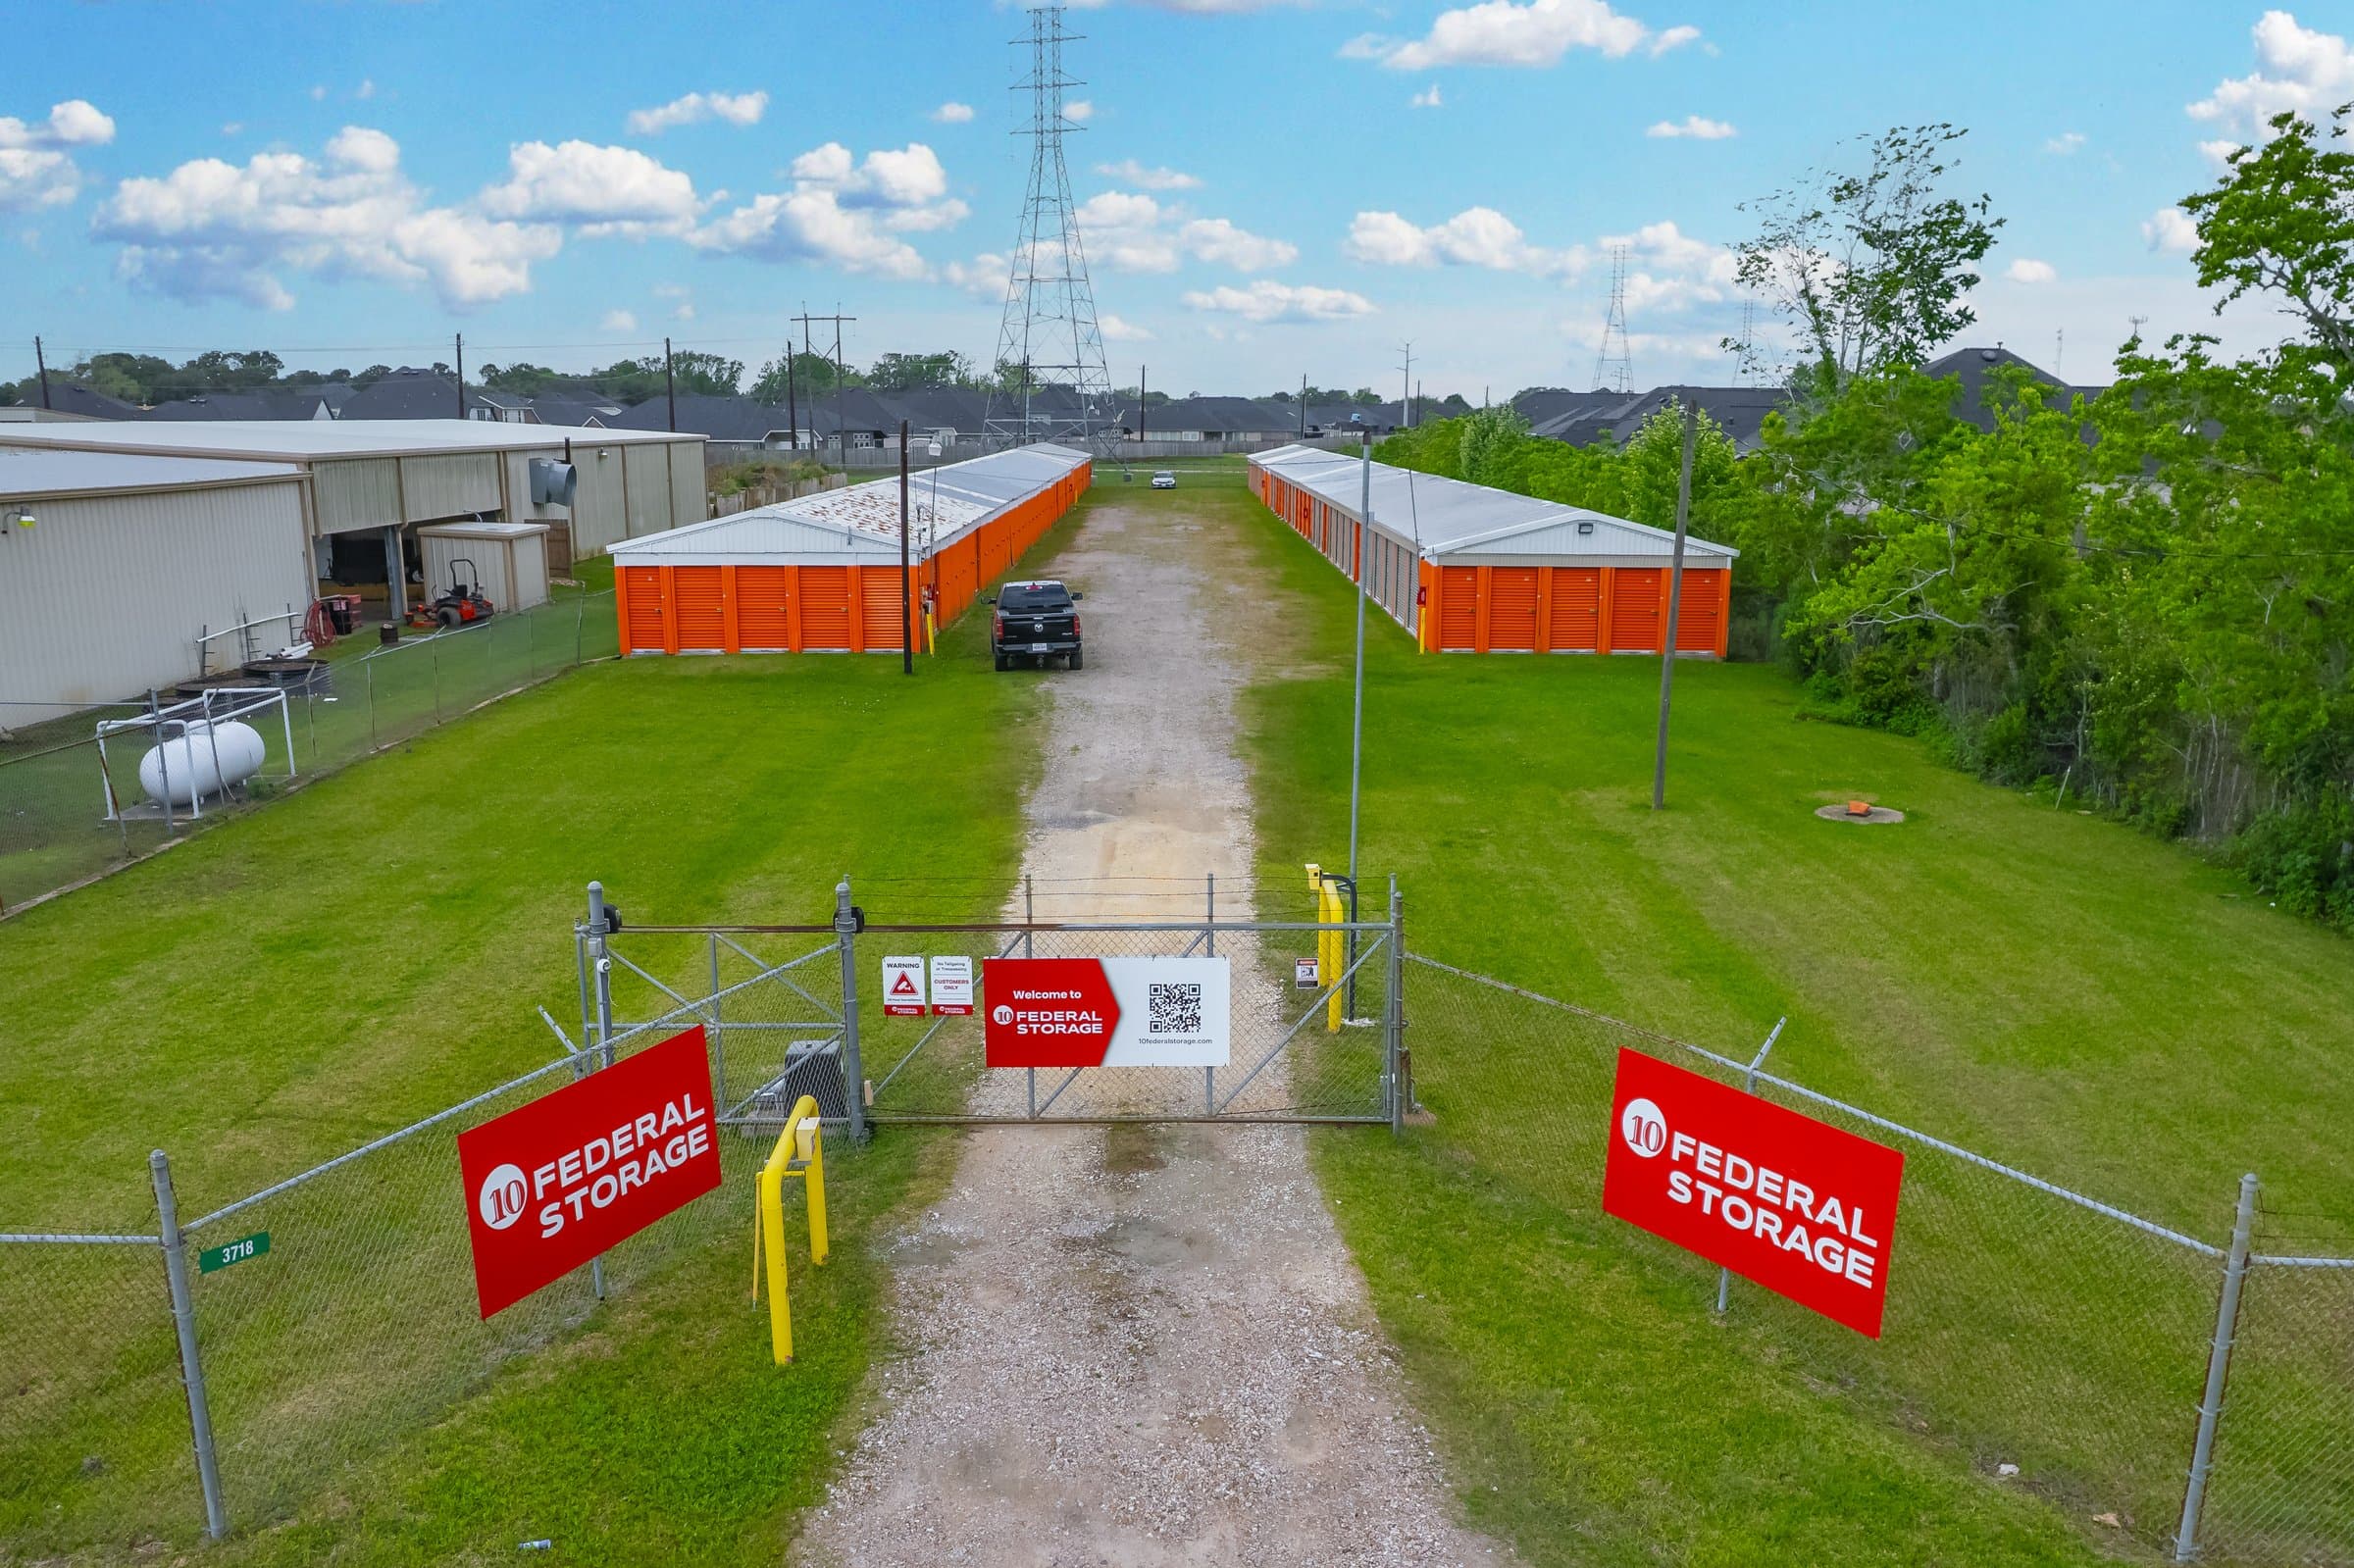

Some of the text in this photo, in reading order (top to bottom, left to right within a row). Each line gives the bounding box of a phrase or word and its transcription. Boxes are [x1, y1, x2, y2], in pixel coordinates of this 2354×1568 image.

[998, 1010, 1102, 1022] 10 FEDERAL
[1013, 989, 1082, 999] Welcome to
[1017, 1023, 1103, 1035] STORAGE
[490, 1092, 705, 1224] 10 FEDERAL
[539, 1123, 709, 1239] STORAGE
[1629, 1115, 1878, 1248] 10 FEDERAL
[222, 1239, 254, 1263] 3718
[1667, 1170, 1875, 1290] STORAGE
